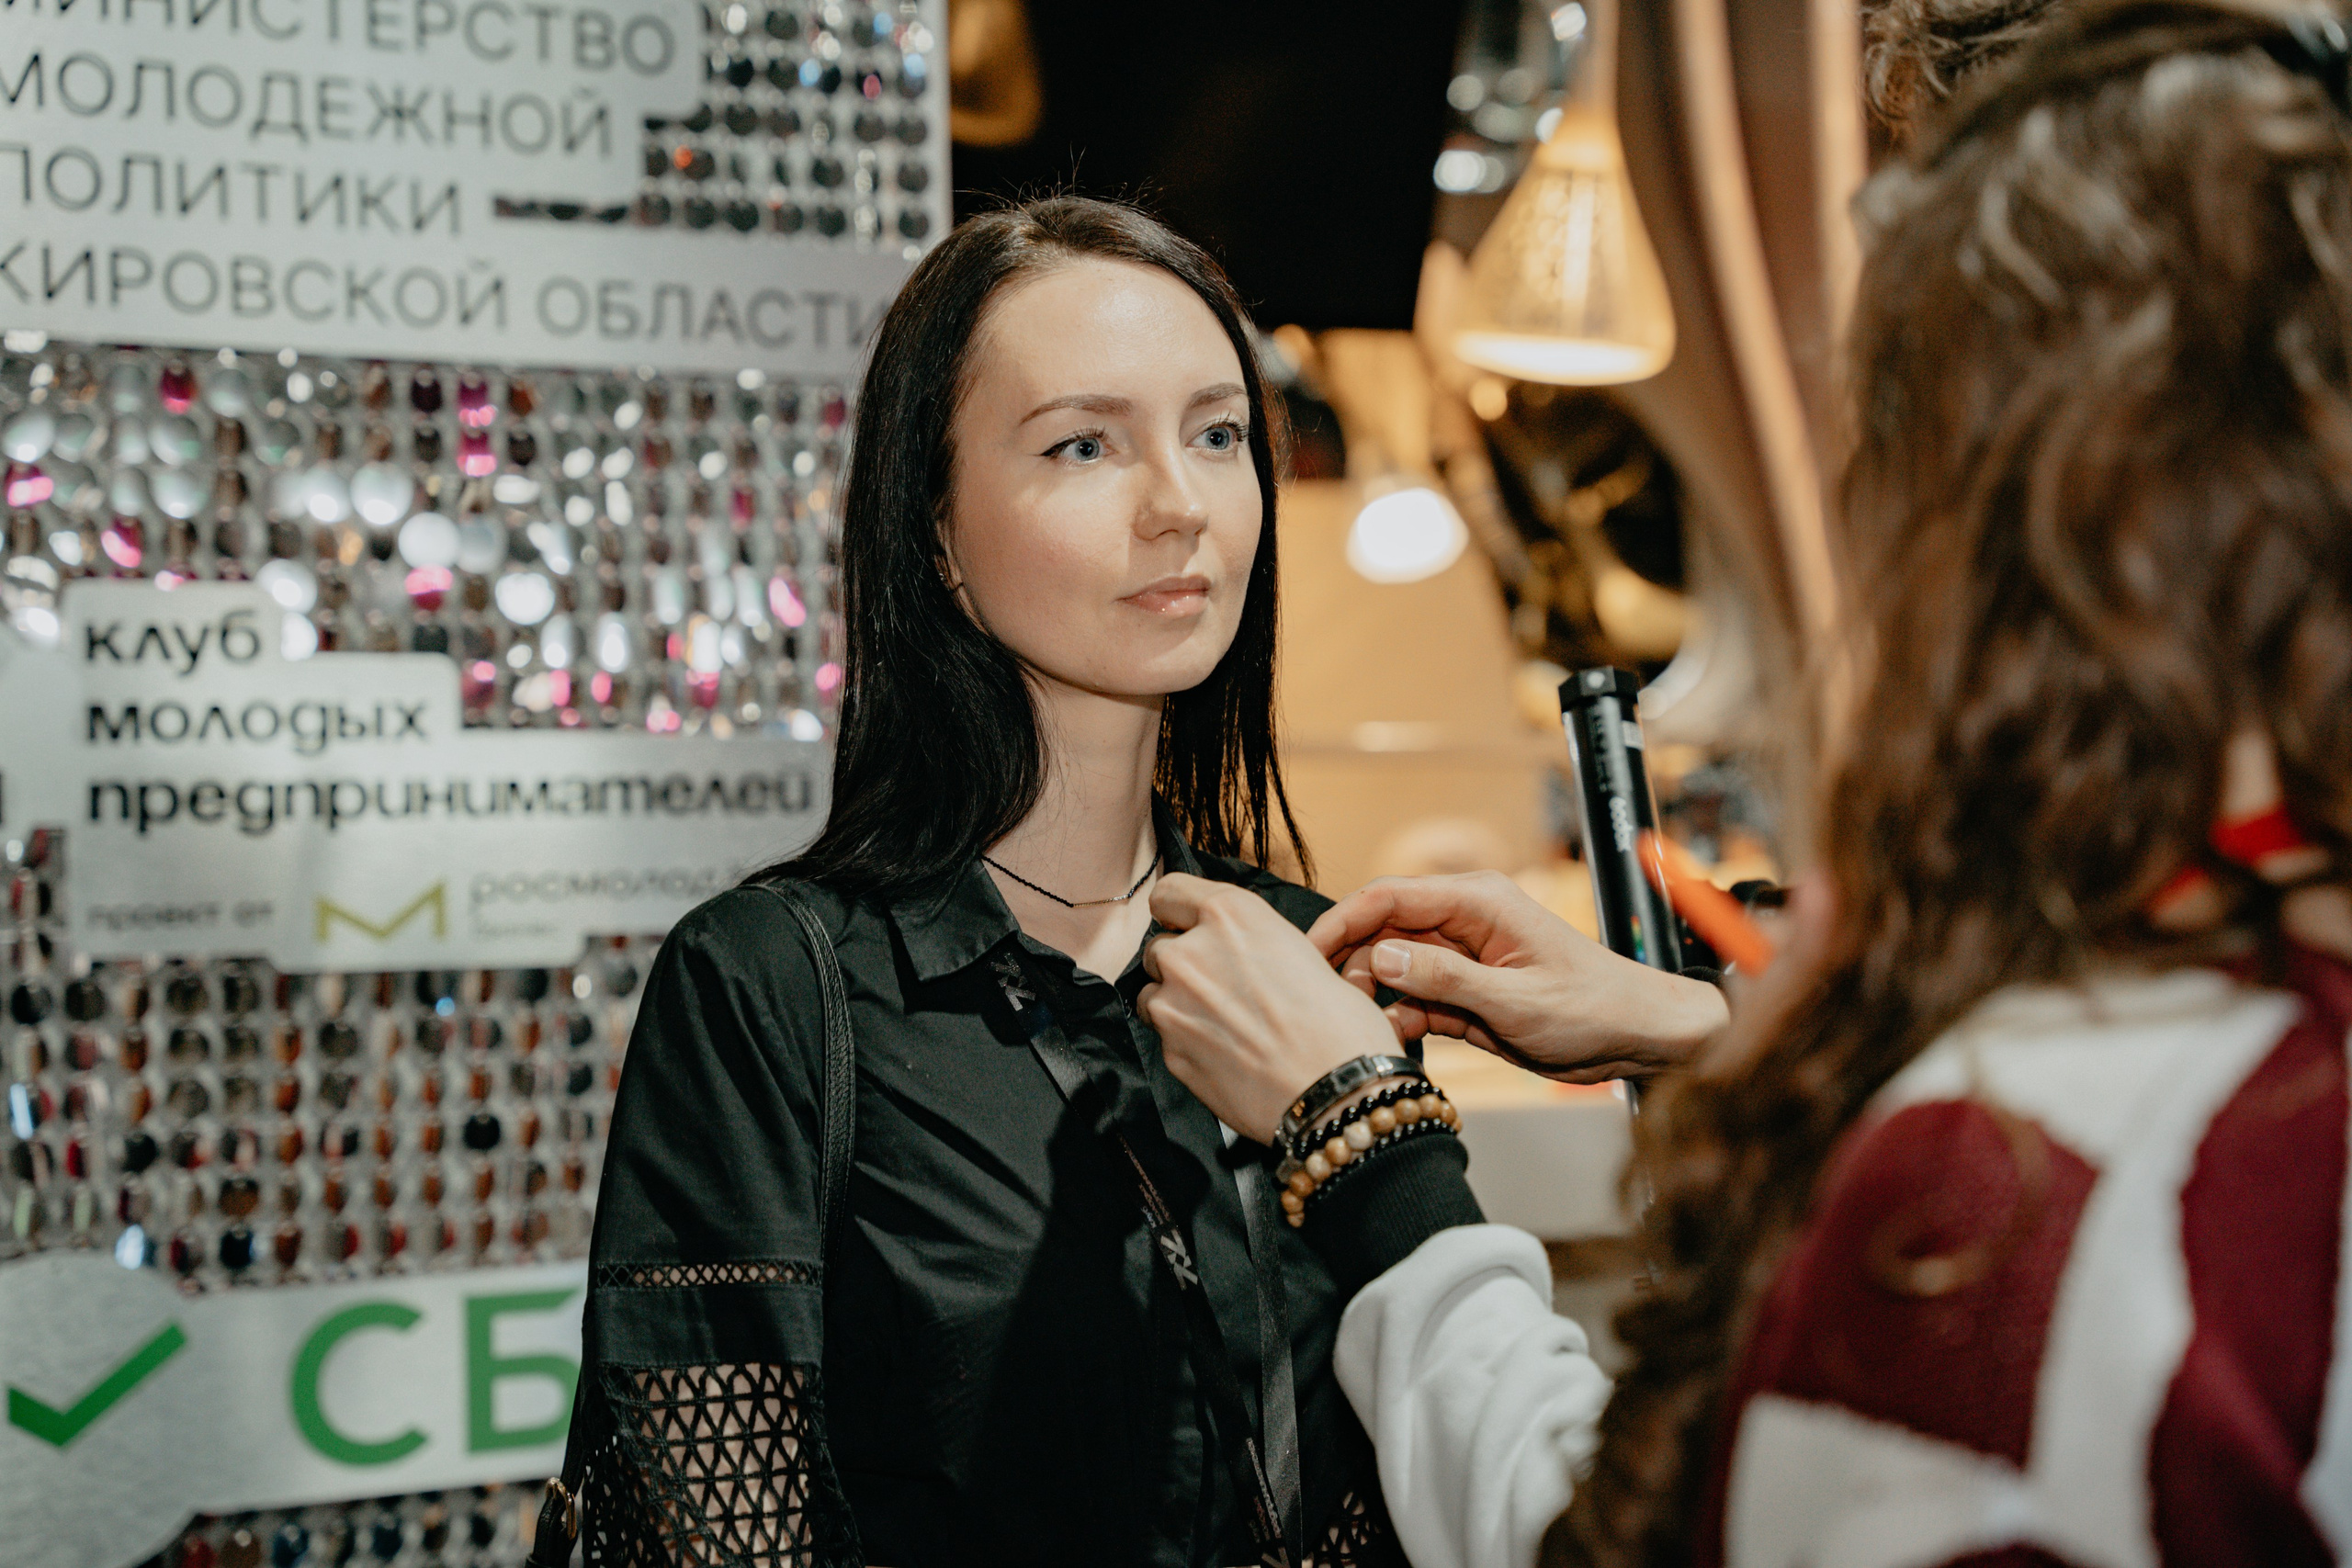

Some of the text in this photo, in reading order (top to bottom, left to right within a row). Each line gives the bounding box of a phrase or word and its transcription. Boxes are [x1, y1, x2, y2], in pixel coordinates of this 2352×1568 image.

[0, 0, 675, 76] ИСТЕРСТВО
[0, 52, 612, 157] МОЛОДЕЖНОЙ
[0, 144, 461, 236] ПОЛИТИКИ
[0, 241, 507, 329] КИРОВСКОЙ
[87, 610, 261, 677] клуб
[89, 702, 429, 756] молодых
[89, 764, 814, 836] предпринимателей
